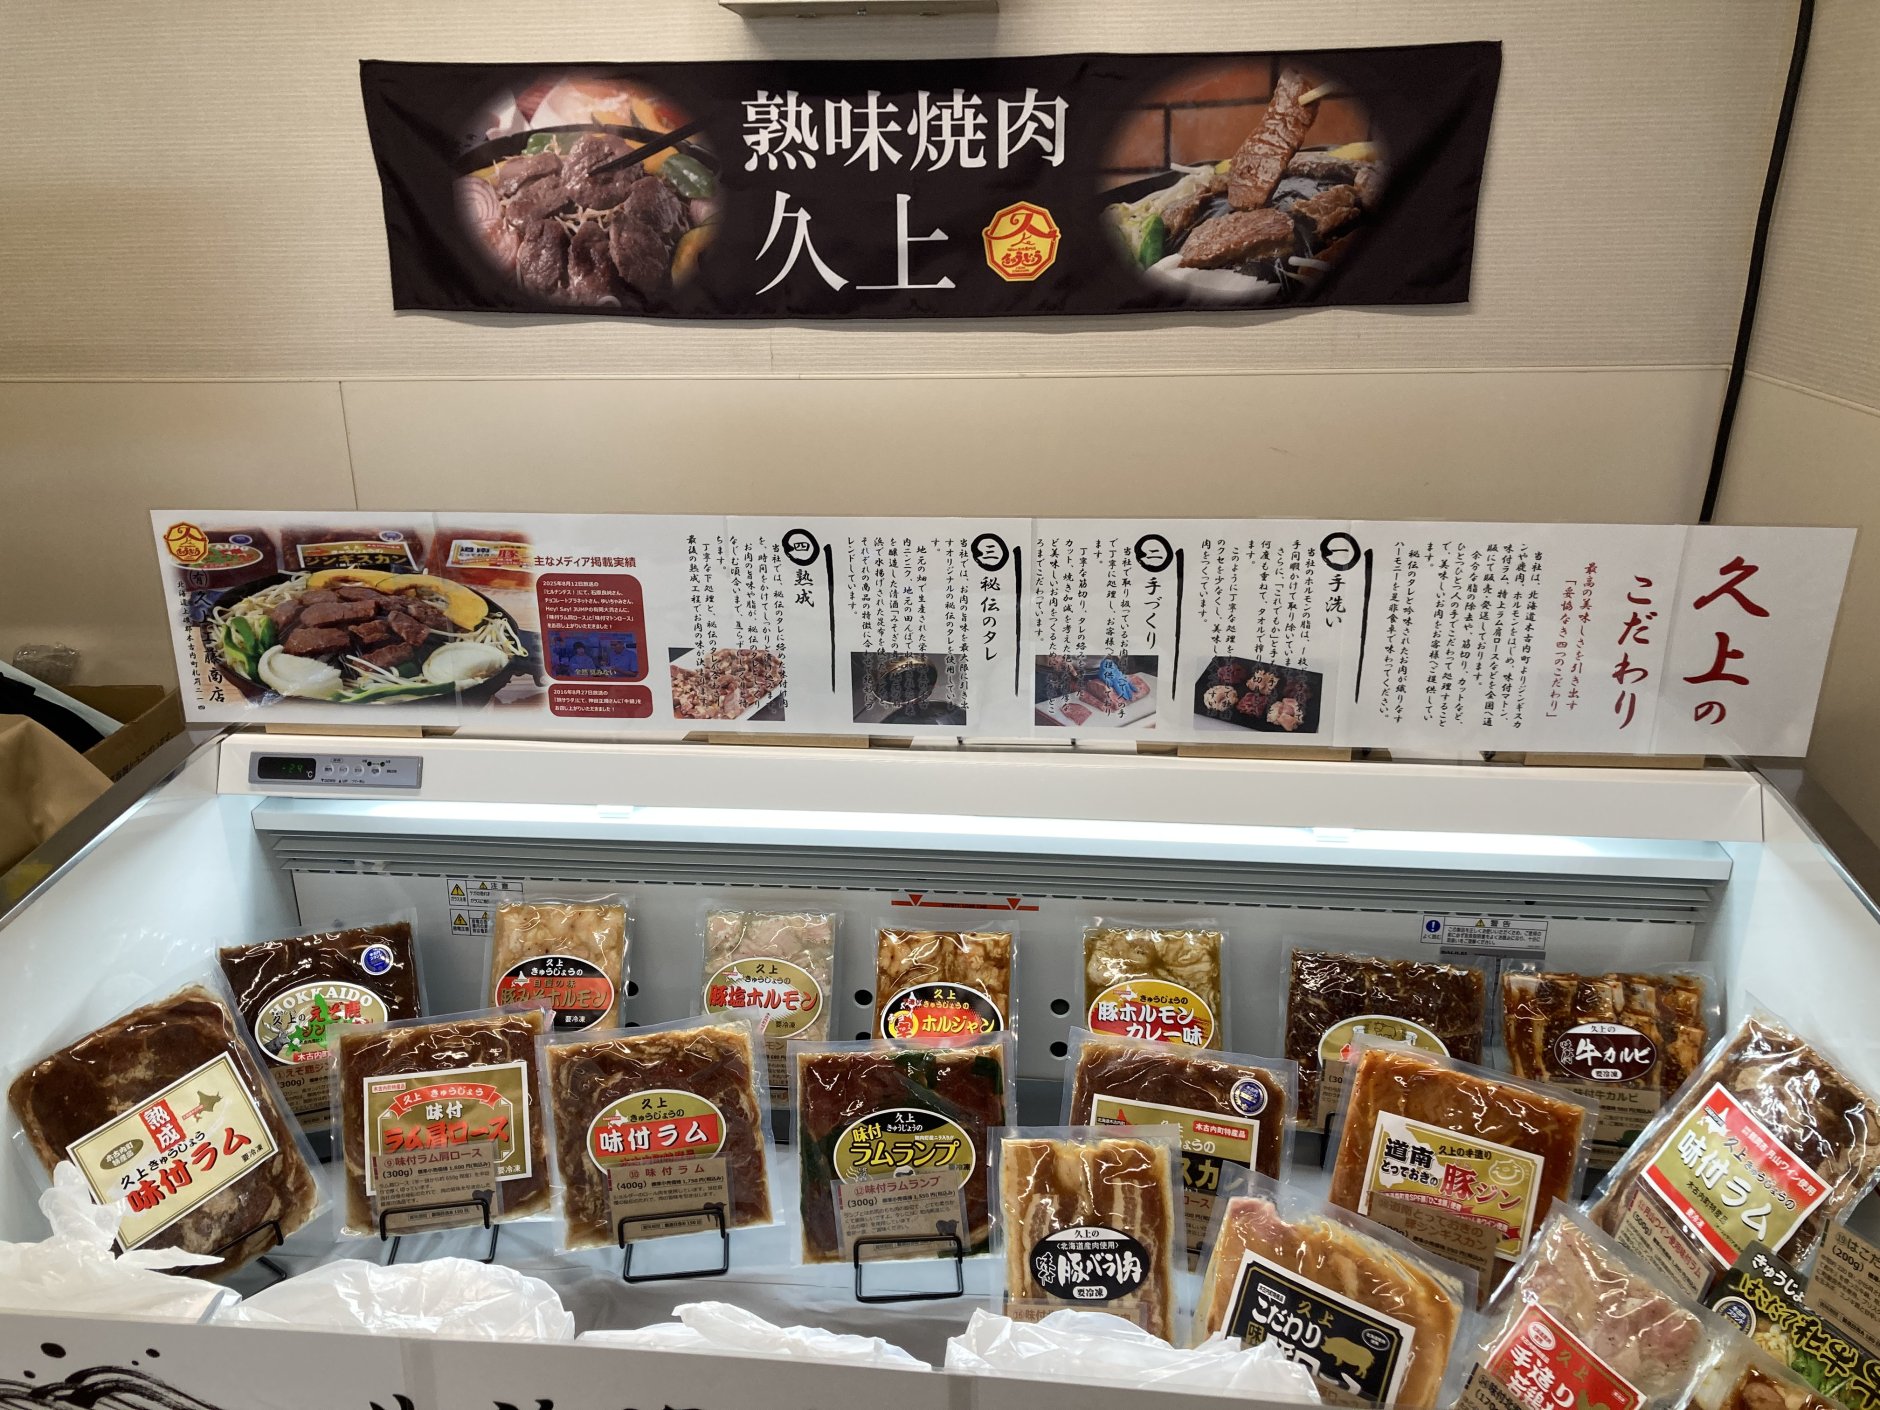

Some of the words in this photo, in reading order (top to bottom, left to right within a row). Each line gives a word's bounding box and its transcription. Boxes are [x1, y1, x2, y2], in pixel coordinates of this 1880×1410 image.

[741, 88, 1070, 172] 熟味焼肉
[755, 190, 956, 295] 久上
[534, 556, 637, 568] 主なメディア掲載実績
[1245, 539, 1256, 564] ます。
[1424, 542, 1435, 567] ます。
[794, 569, 815, 608] 熟成
[1198, 539, 1212, 623] 肉をつくっています。
[1144, 577, 1163, 650] 手づくり
[1325, 573, 1347, 628] 手洗い
[980, 577, 1001, 661] 秘伝のタレ
[1546, 579, 1577, 718] 「妥協なき四つのこだわり」
[1565, 562, 1598, 711] 最高の美味しさを引き出す
[1683, 556, 1770, 725] 久上の
[1612, 575, 1658, 730] こだわり
[530, 966, 583, 976] きゅうじょうの
[546, 958, 564, 967] 久上
[755, 963, 779, 974] 久上
[744, 974, 791, 984] きゅうじょうの
[269, 986, 374, 1016] HOKKAIDO
[501, 986, 608, 1008] 豚みそホルモン
[709, 984, 818, 1011] 豚塩ホルモン
[933, 988, 956, 1000] 久上
[1140, 994, 1188, 1005] きゅうじょうの
[309, 1001, 362, 1023] えぞ鹿
[564, 1015, 586, 1023] 要冷凍
[922, 1014, 995, 1034] ホルジャン
[1097, 1001, 1195, 1025] 豚ホルモン
[1125, 1022, 1203, 1046] カレー味
[1591, 1025, 1616, 1033] 久上の
[1575, 1037, 1652, 1067] 牛カルビ
[403, 1094, 422, 1106] 久上
[430, 1085, 484, 1098] きゅうじょう
[641, 1097, 668, 1110] 久上
[425, 1100, 464, 1121] 味付
[629, 1109, 685, 1122] きゅうじょうの
[895, 1112, 916, 1123] 久上
[143, 1105, 182, 1148] 熟成
[383, 1115, 510, 1154] ラム肩ロース
[599, 1121, 708, 1153] 味付ラム
[852, 1122, 882, 1143] 味付
[886, 1123, 923, 1132] きゅうじょうの
[1194, 1121, 1247, 1138] 木古内町特産品
[121, 1167, 149, 1190] 久上
[148, 1131, 206, 1172] きゅうじょう
[384, 1148, 482, 1168] ⑨味付ラム肩ロース
[849, 1140, 961, 1168] ラムランプ
[1384, 1137, 1435, 1169] 道南
[1723, 1136, 1748, 1163] 久上
[124, 1127, 252, 1213] 味付ラム
[1381, 1159, 1439, 1186] とっておきの
[1439, 1163, 1522, 1212] 豚ジン
[1677, 1129, 1773, 1242] 味付ラム
[1074, 1229, 1100, 1238] 久上の
[1057, 1250, 1143, 1288] 豚バラ肉
[1077, 1288, 1104, 1298] 要冷凍
[1251, 1295, 1323, 1349] こだわり
[1296, 1300, 1335, 1329] 久上
[1510, 1343, 1575, 1409] 手造り
